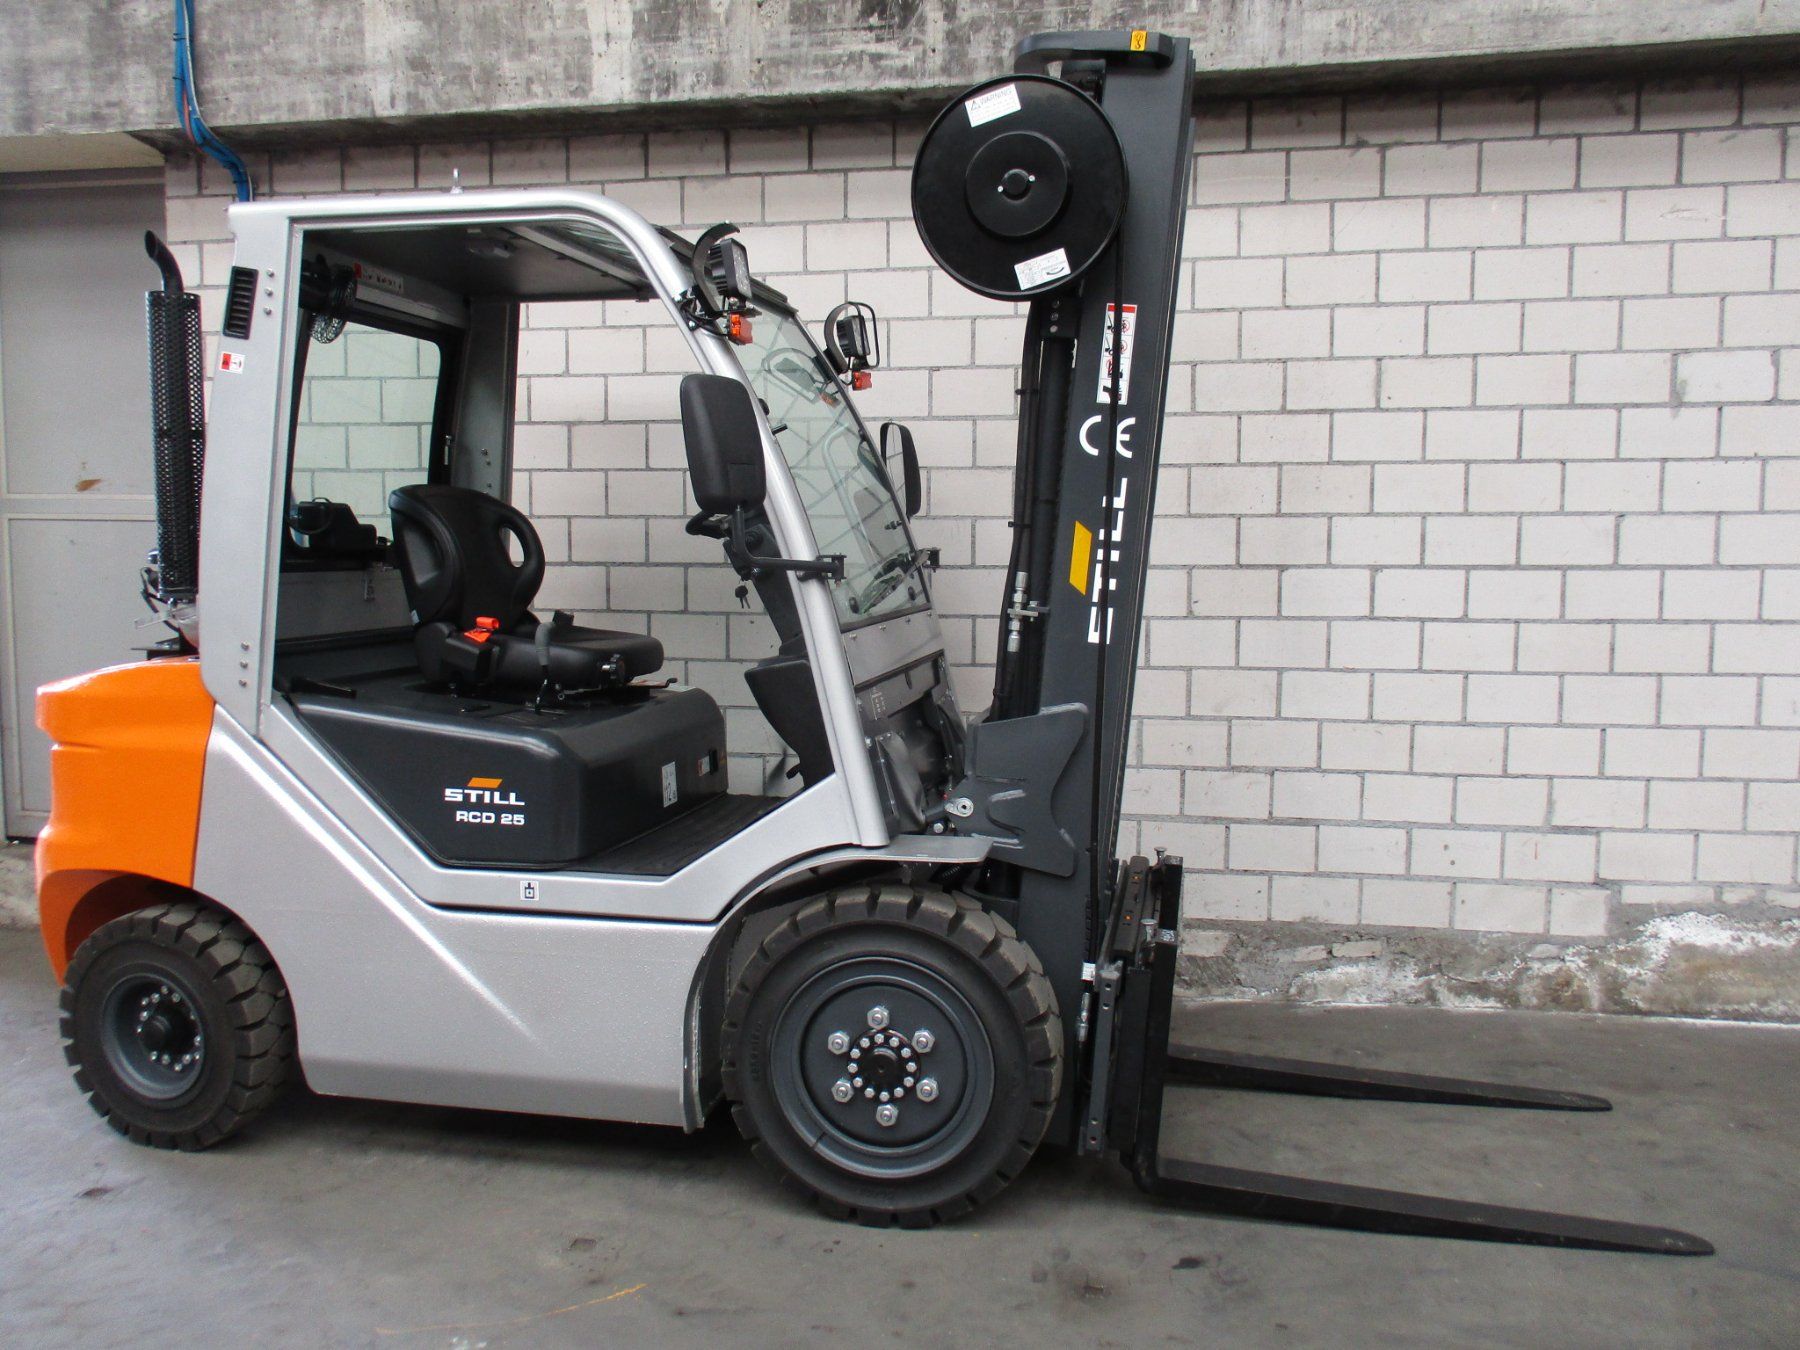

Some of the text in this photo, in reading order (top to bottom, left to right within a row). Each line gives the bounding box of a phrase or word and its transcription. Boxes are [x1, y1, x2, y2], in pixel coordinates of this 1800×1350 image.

[444, 788, 525, 806] STILL
[456, 810, 525, 826] RCD 25
